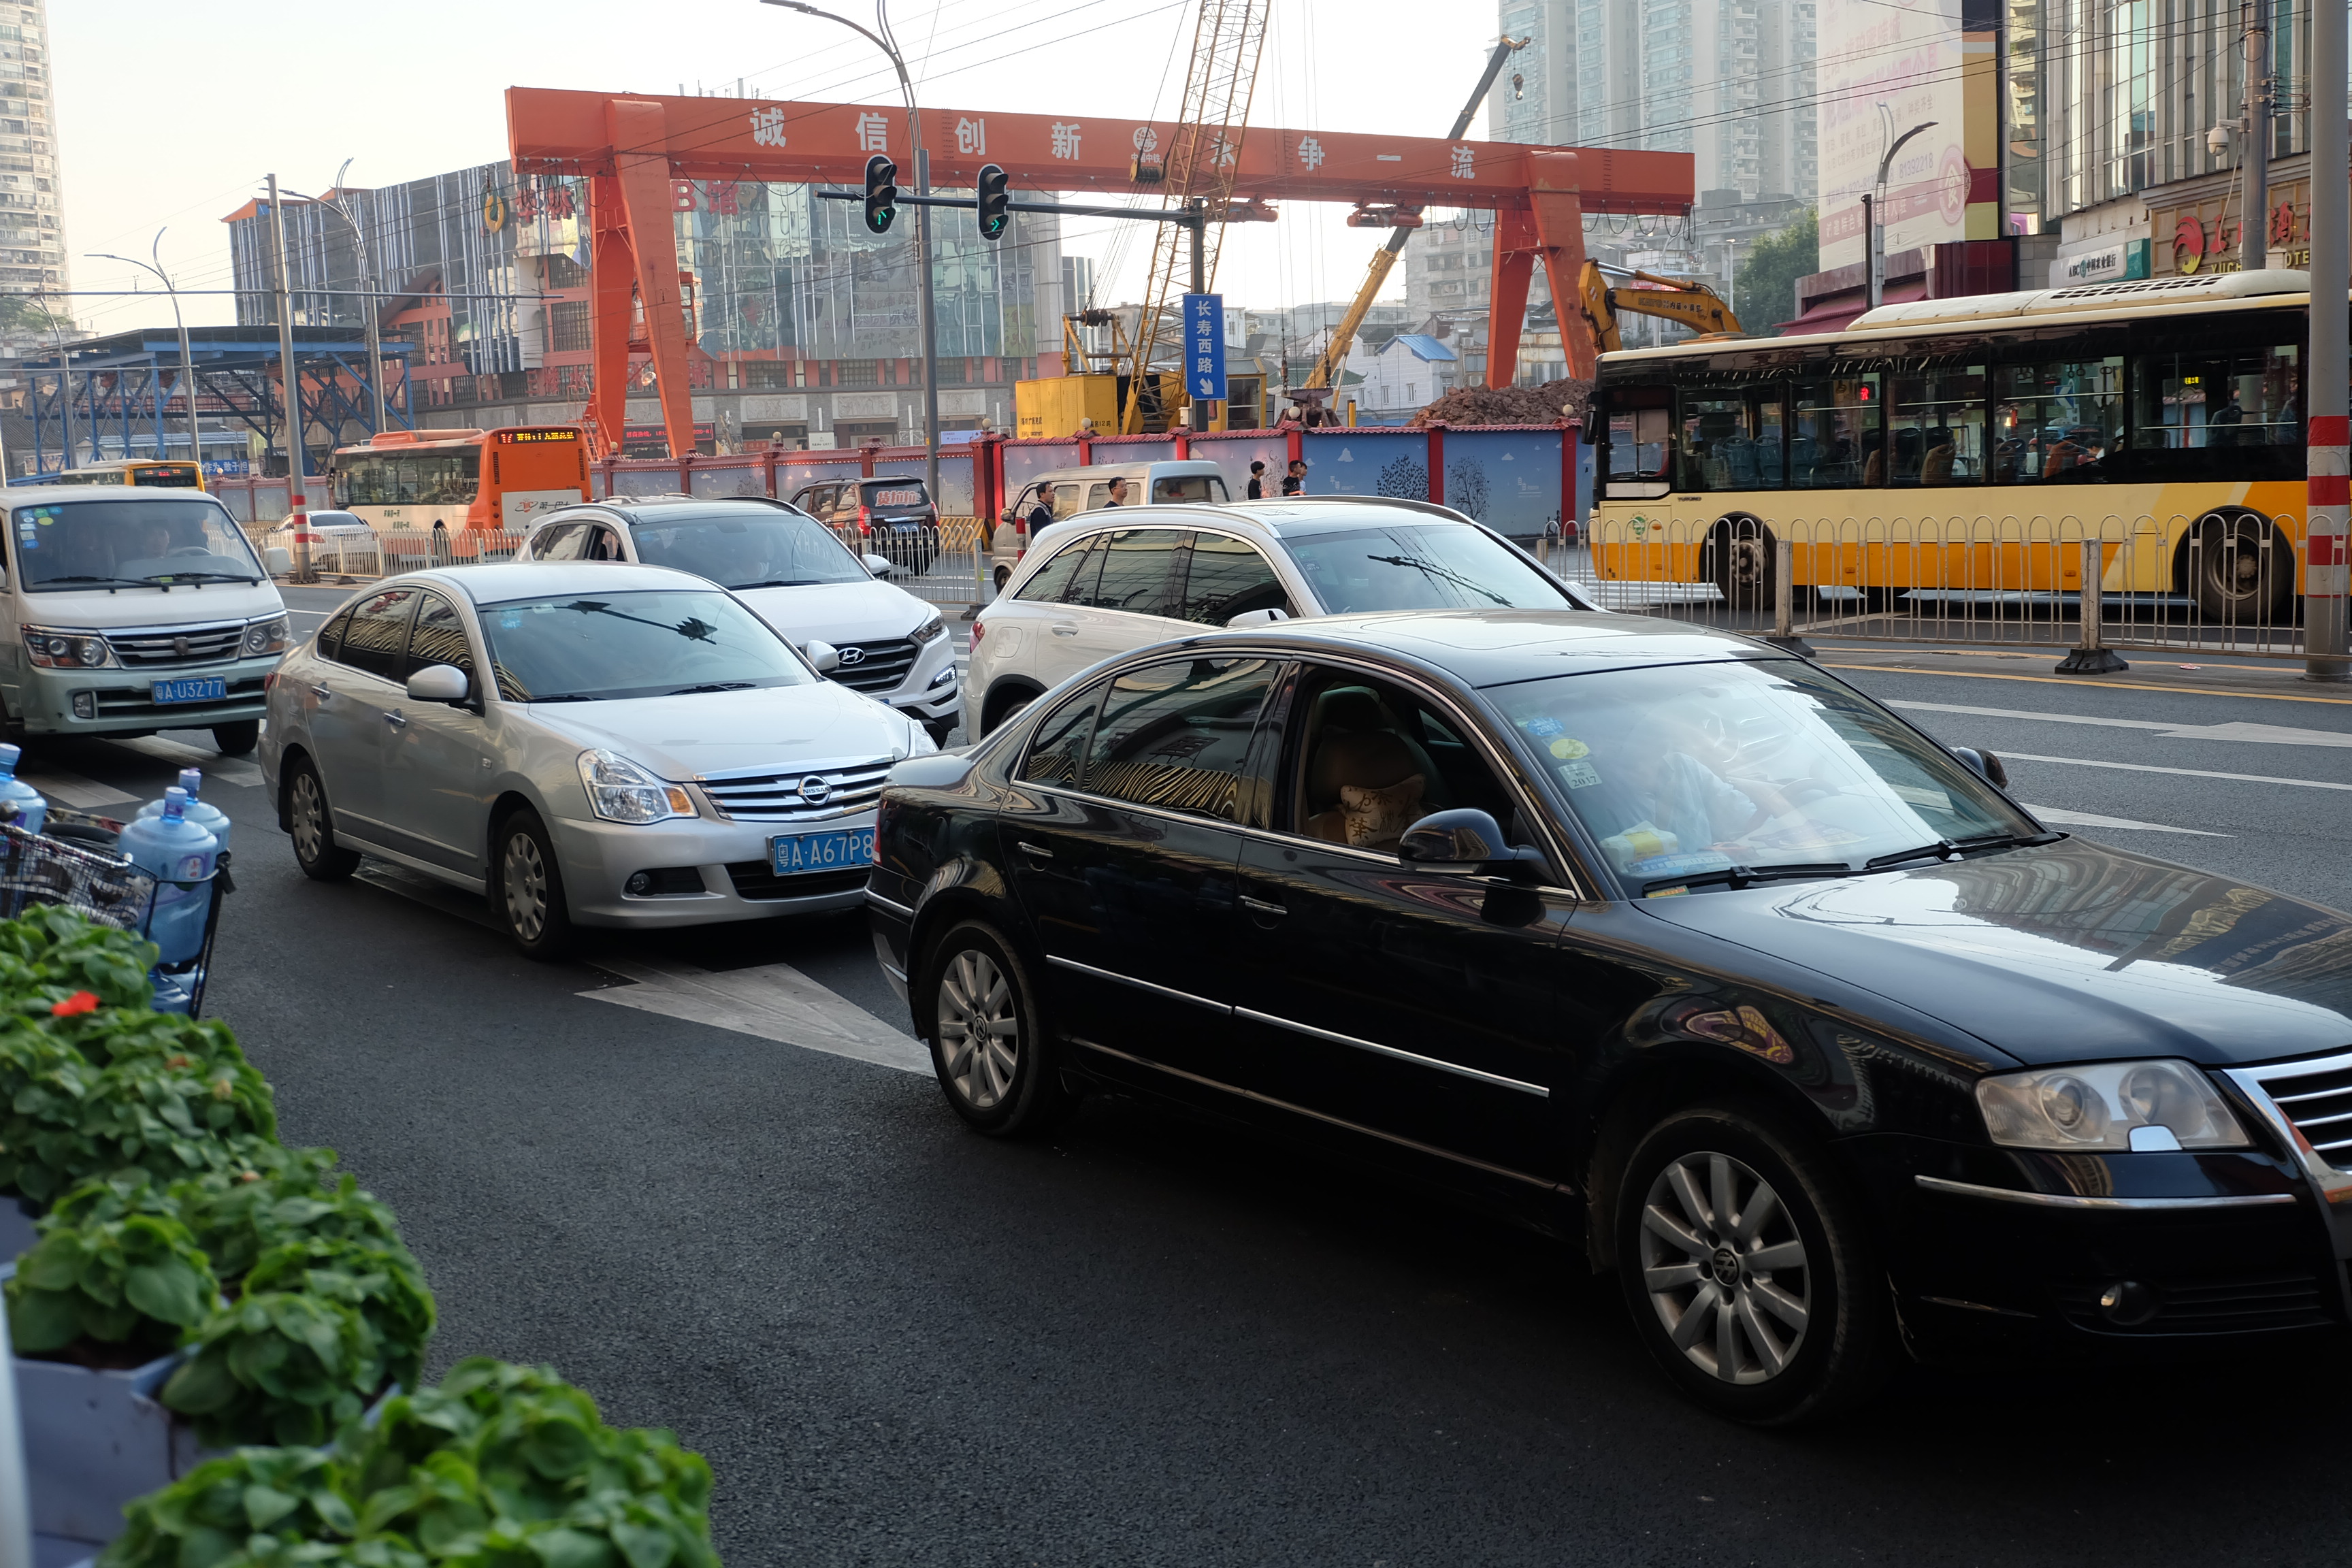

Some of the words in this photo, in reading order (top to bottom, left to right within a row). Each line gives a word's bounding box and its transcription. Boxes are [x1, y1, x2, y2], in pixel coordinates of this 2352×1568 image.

[749, 107, 1081, 161] 诚信创新
[1899, 152, 1933, 178] 81392218
[2069, 264, 2080, 278] ABC
[2087, 253, 2116, 272] 中国农业银行
[1196, 300, 1213, 374] 长寿西路
[875, 490, 919, 506] 货拉拉
[1572, 777, 1597, 787] 2017
